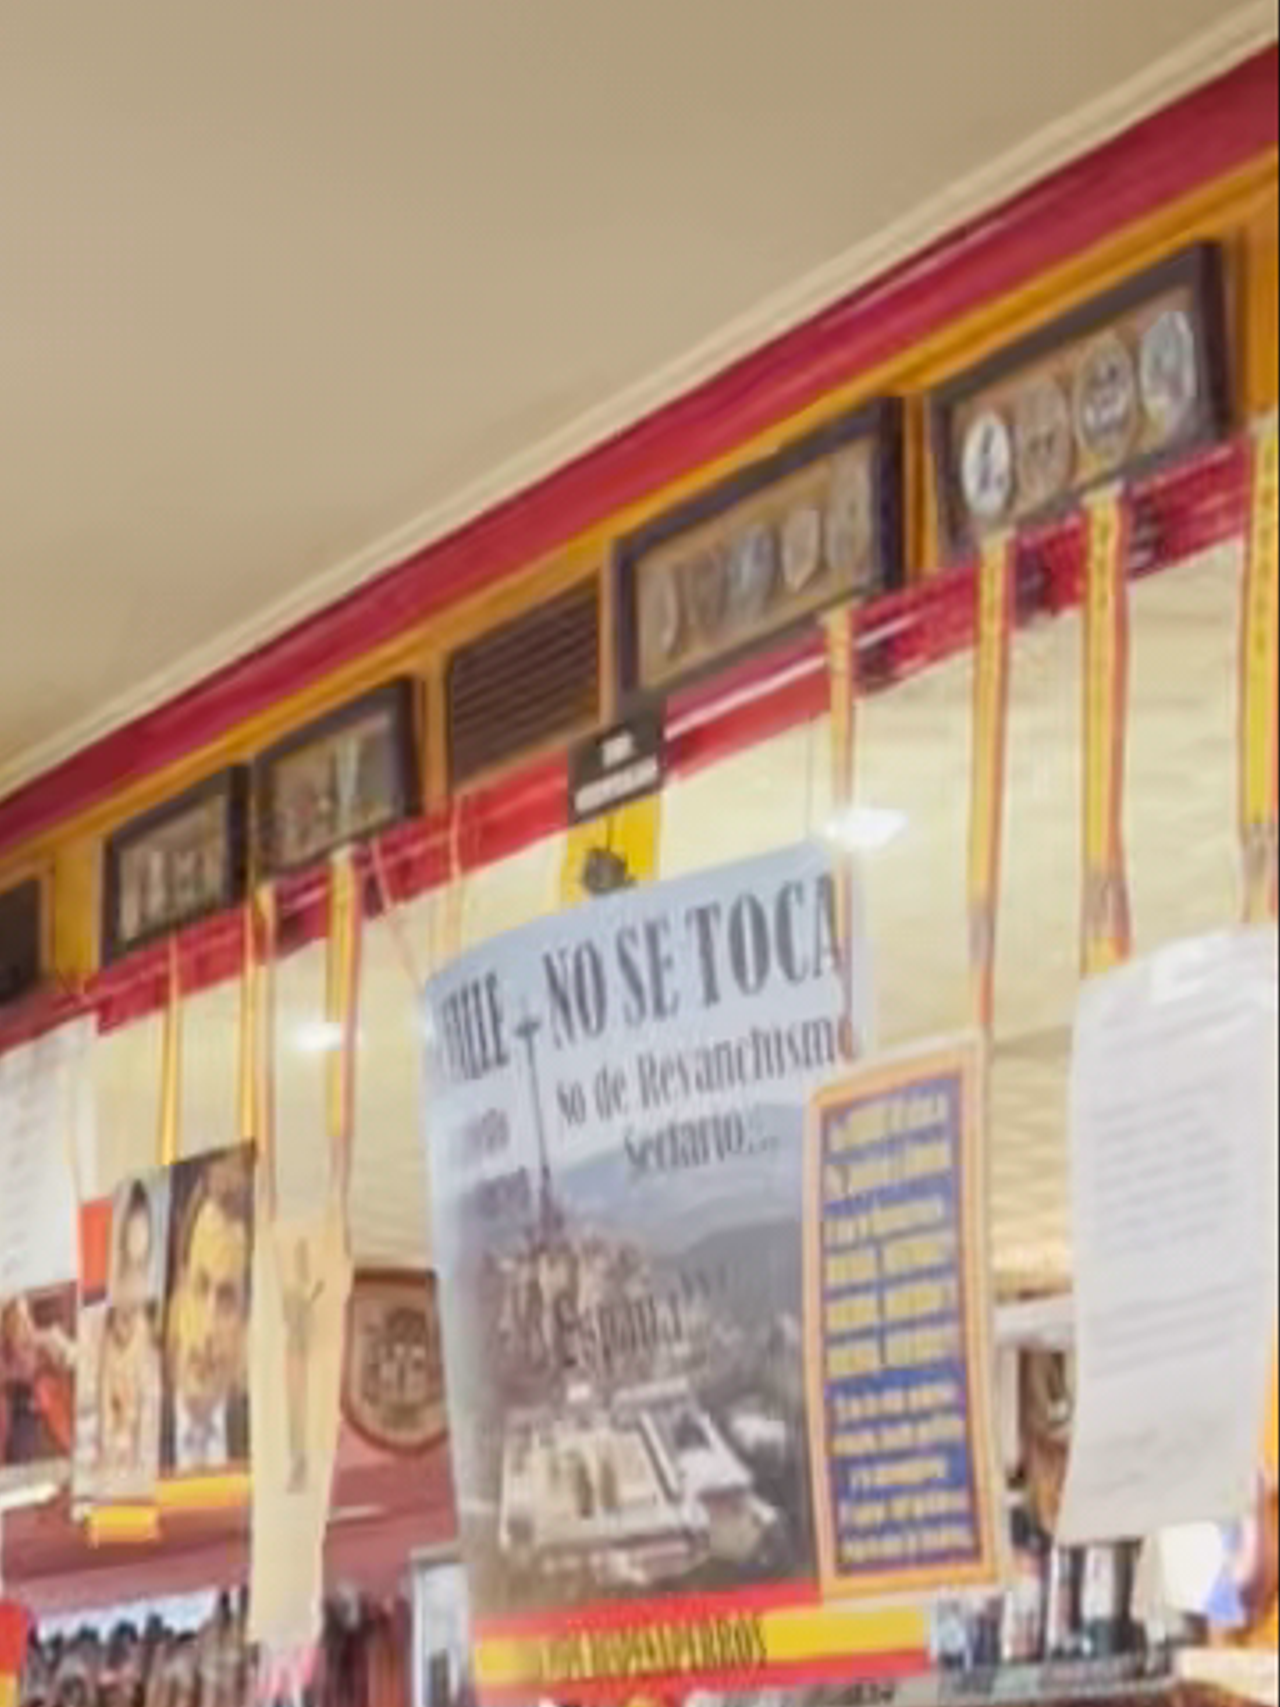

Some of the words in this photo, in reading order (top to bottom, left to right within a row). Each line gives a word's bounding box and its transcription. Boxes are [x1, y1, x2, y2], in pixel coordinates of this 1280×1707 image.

[543, 939, 608, 1051] NO
[616, 917, 681, 1029] SE
[685, 872, 840, 1009] TOCA
